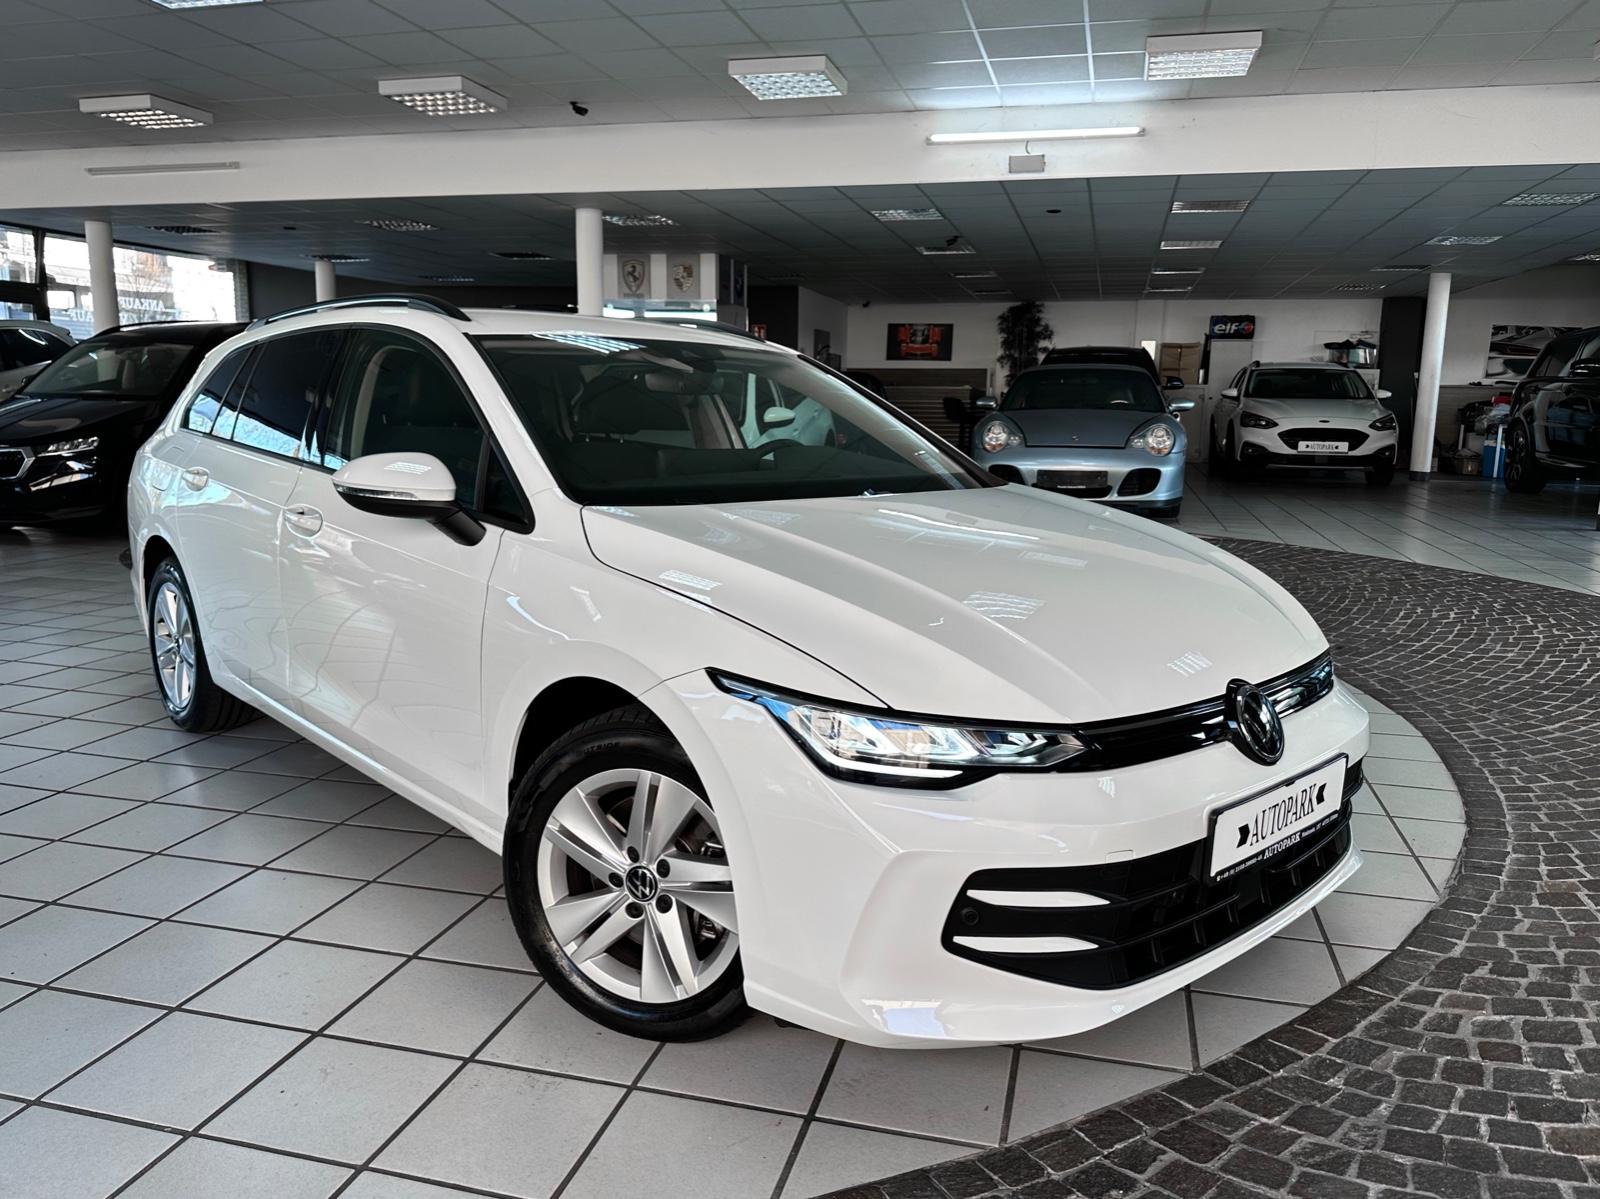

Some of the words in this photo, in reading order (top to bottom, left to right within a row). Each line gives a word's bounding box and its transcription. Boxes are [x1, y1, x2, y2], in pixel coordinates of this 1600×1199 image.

[1214, 322, 1240, 334] elf
[1250, 783, 1316, 847] AUTOPARK
[1263, 832, 1301, 859] AUTOPARK
